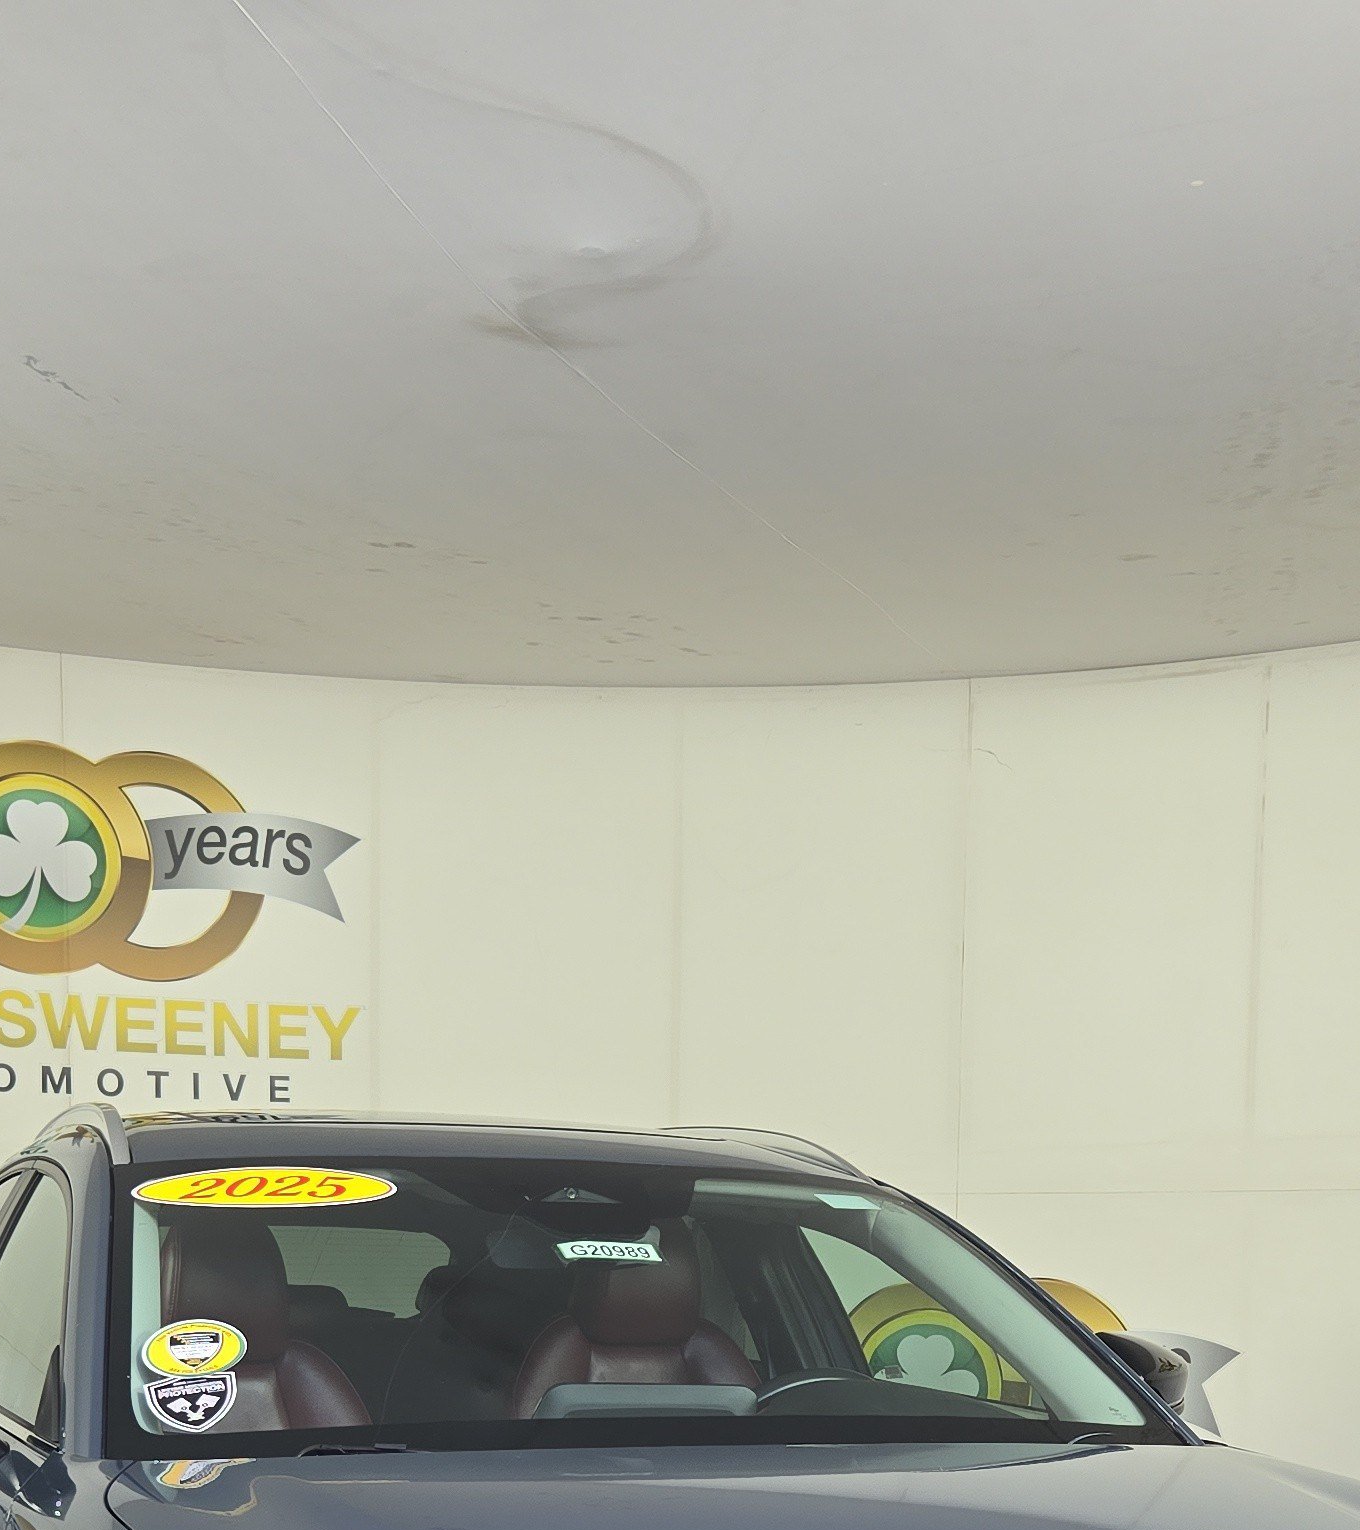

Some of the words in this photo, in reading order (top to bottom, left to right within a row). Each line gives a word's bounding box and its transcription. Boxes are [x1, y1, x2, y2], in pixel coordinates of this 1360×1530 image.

[163, 823, 314, 878] years
[180, 1174, 355, 1201] 2025
[570, 1244, 651, 1259] G20989
